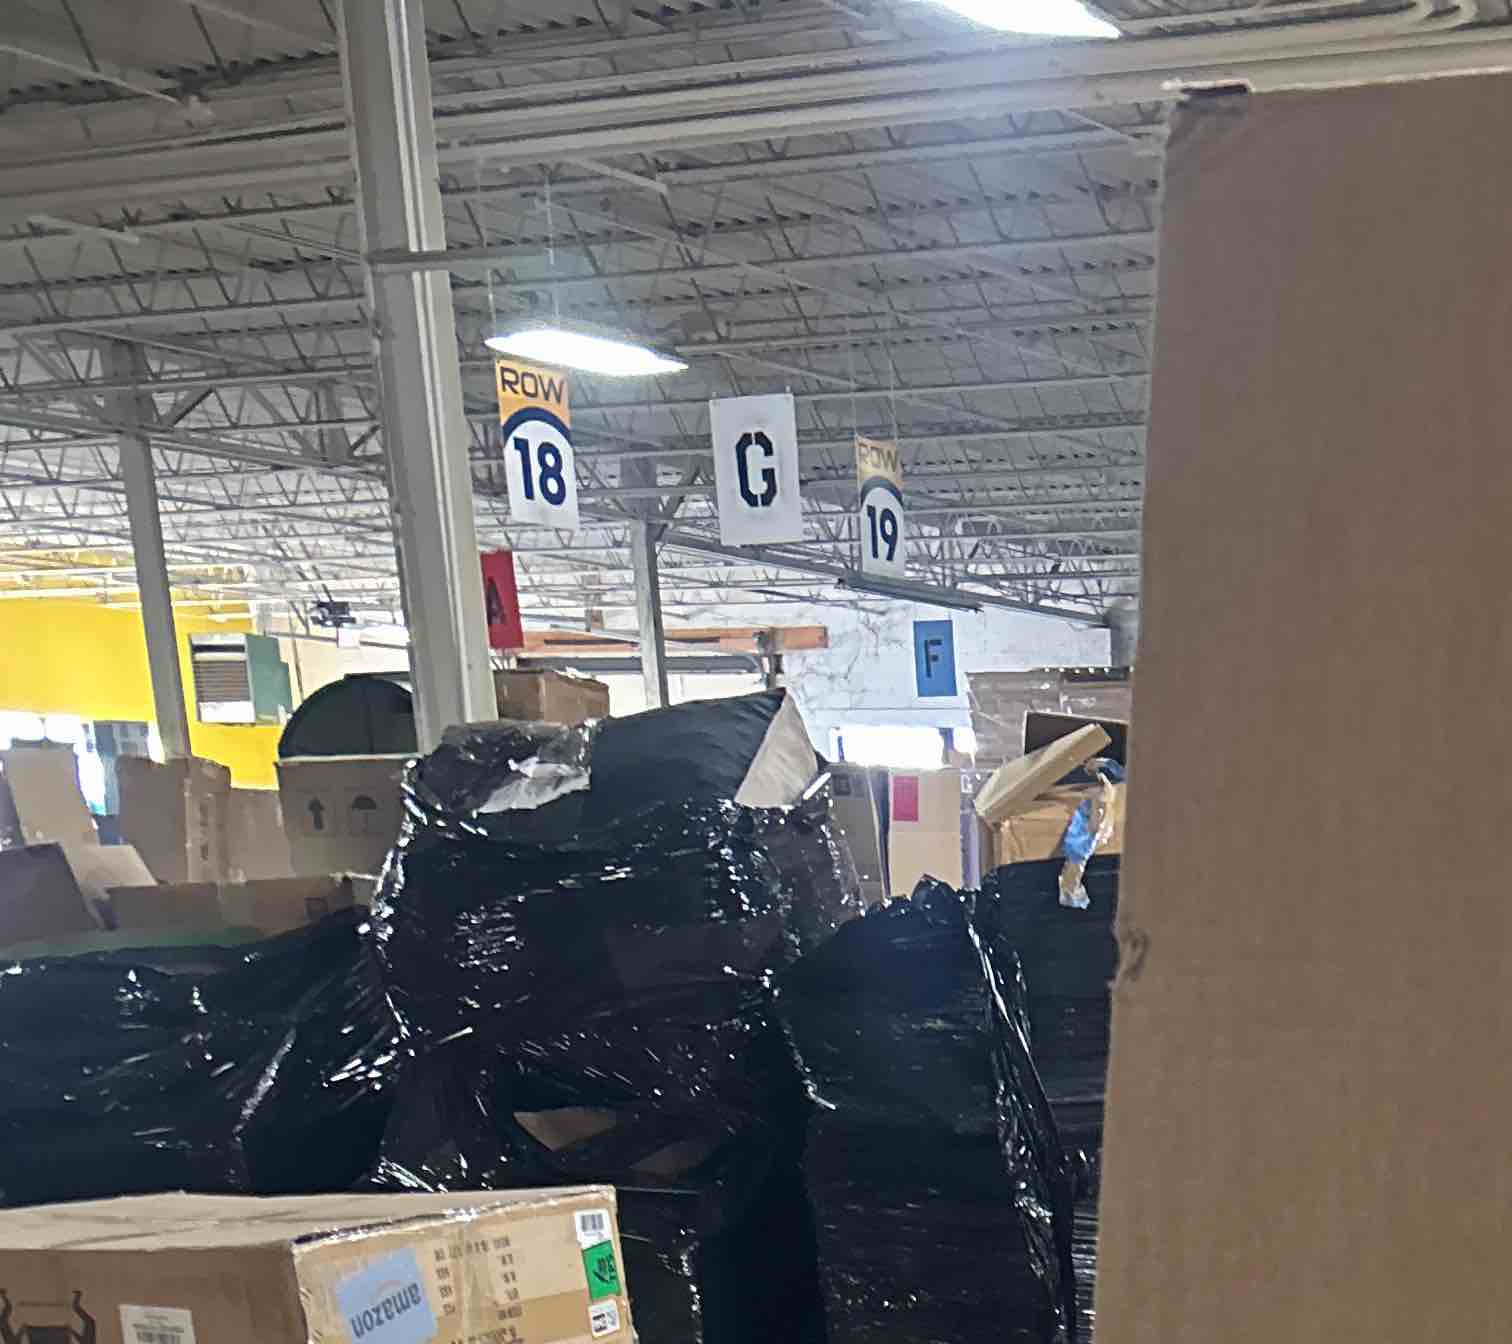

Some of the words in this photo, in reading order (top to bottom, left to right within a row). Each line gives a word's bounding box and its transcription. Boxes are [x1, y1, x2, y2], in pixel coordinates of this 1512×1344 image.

[500, 366, 565, 404] ROW
[513, 436, 566, 506] 18
[735, 431, 777, 507] G
[866, 504, 898, 561] 19
[924, 639, 943, 679] F
[348, 1283, 423, 1340] amazon
